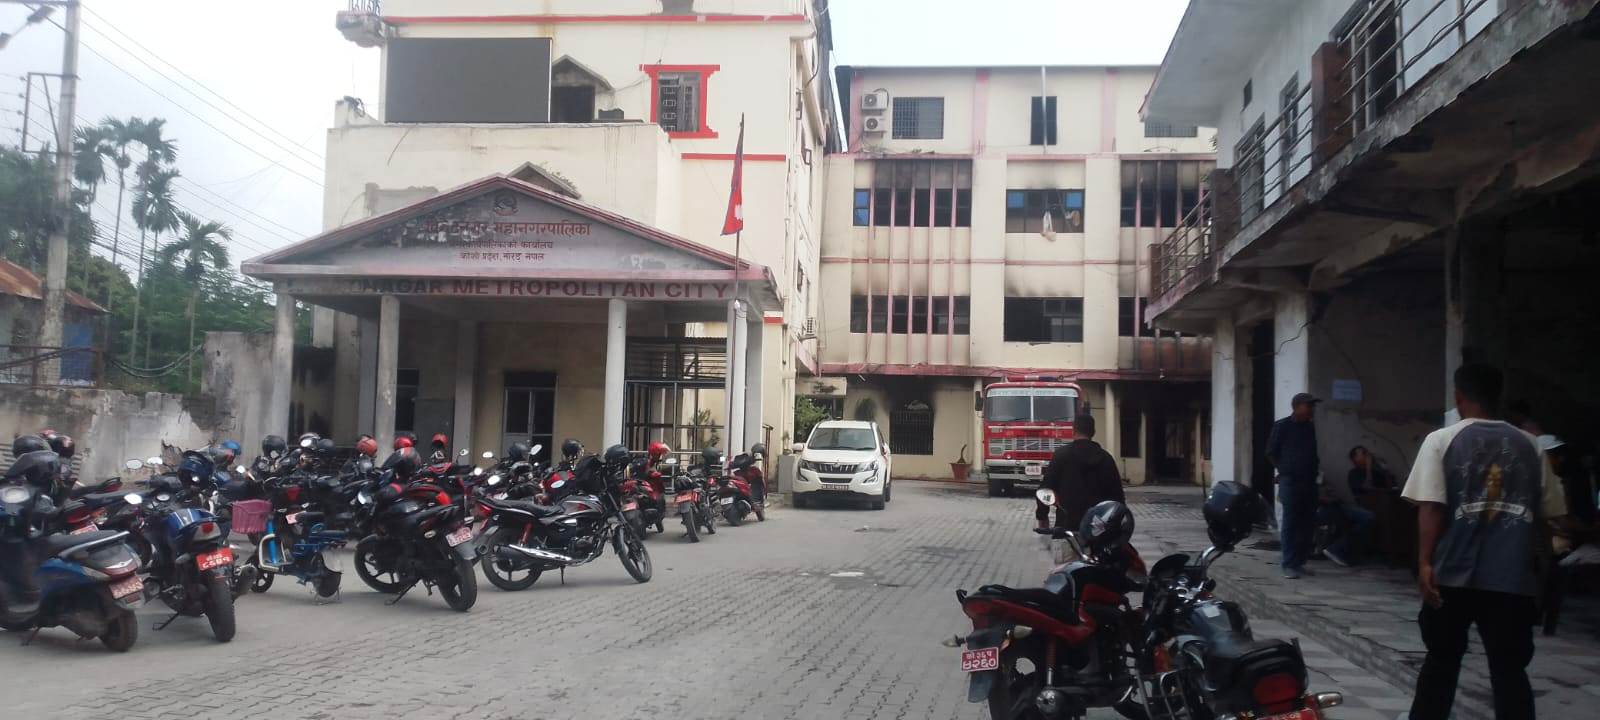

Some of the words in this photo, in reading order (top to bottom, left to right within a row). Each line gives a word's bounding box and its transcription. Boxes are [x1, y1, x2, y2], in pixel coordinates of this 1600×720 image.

[495, 219, 591, 237] महानगरपालिका
[453, 279, 655, 297] METROPOLITAN
[665, 282, 729, 298] CITY
